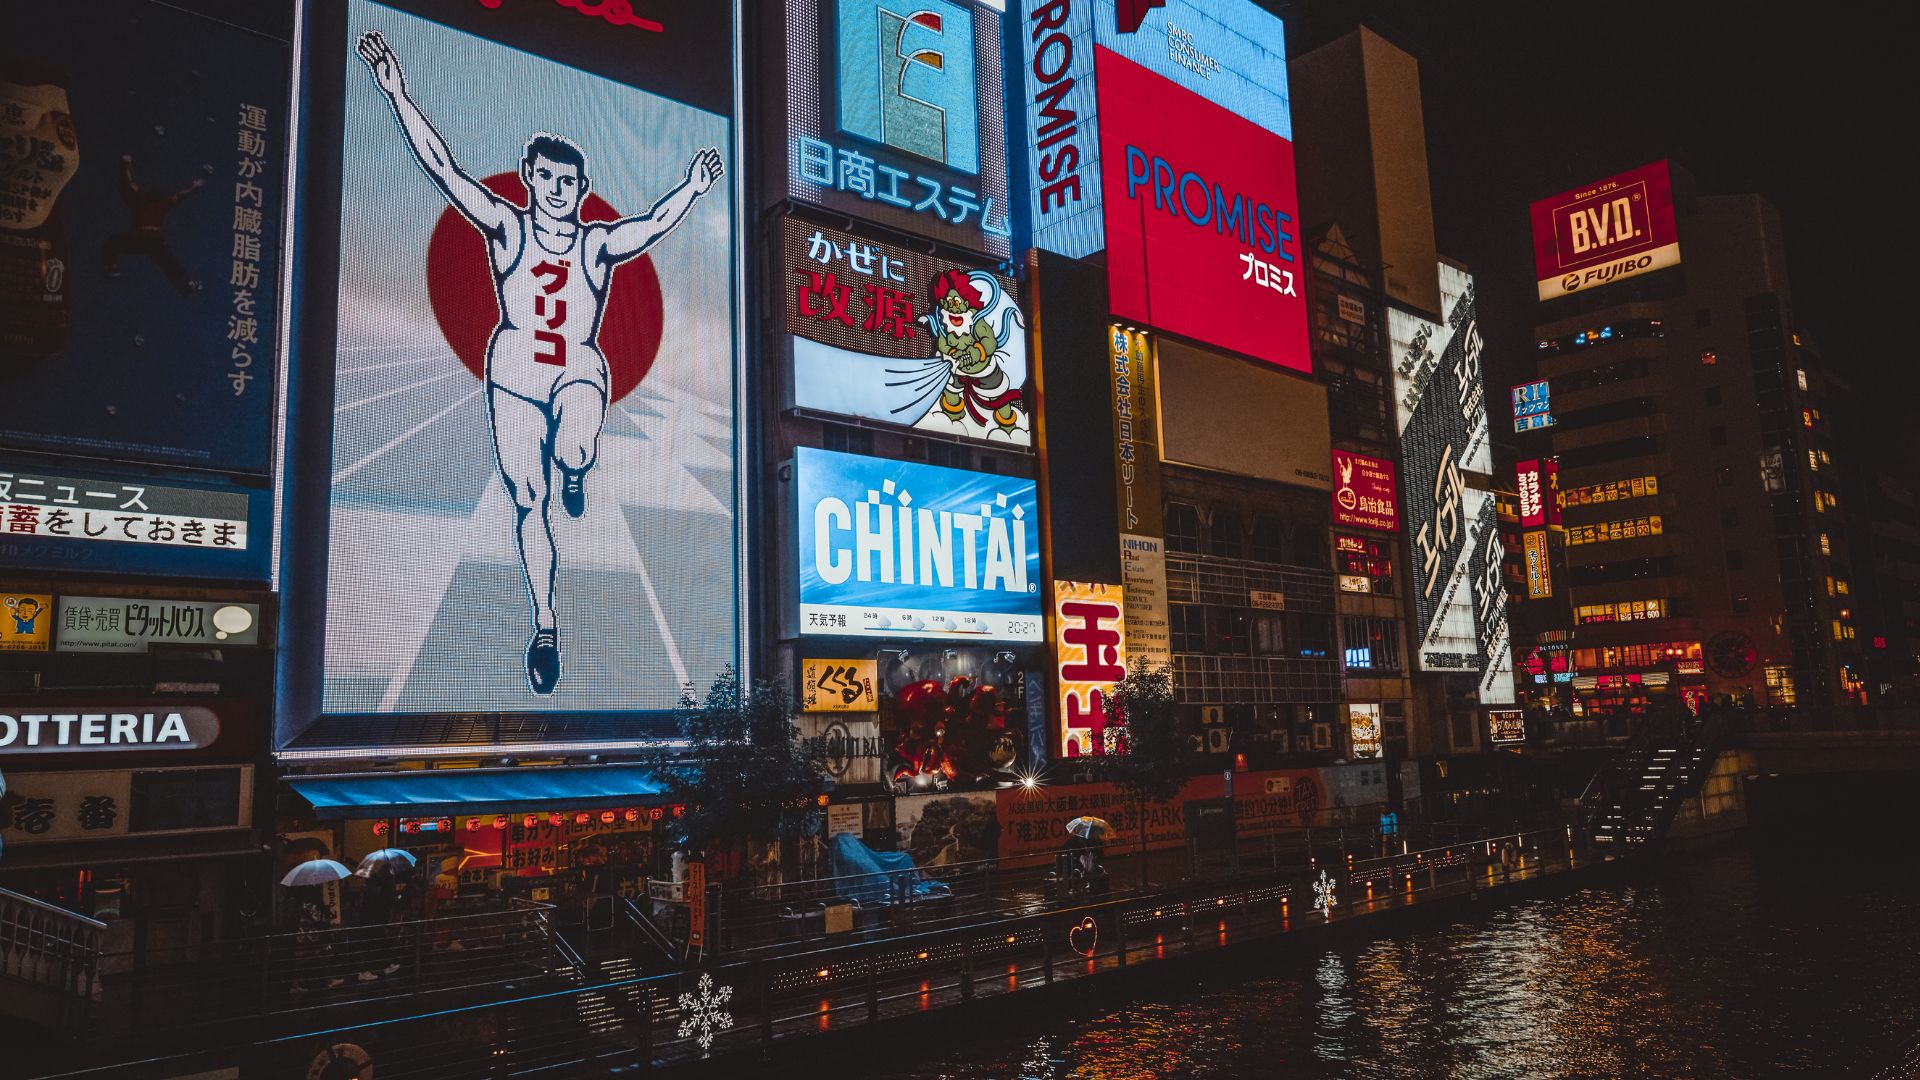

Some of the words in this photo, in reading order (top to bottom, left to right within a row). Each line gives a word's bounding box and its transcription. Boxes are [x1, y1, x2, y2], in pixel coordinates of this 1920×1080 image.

[1167, 21, 1194, 42] SMBC
[1168, 35, 1220, 73] CONSUMER
[1169, 47, 1212, 80] FINANCE
[799, 136, 1012, 237] 日商エステム
[1125, 143, 1295, 262] PROMISE
[1575, 189, 1597, 199] Since
[1569, 196, 1641, 254] B.V.D.
[226, 103, 269, 396] 運動が内臓脂肪を減らす
[806, 230, 906, 283] かぜに
[1583, 255, 1653, 282] FUJIBO
[1239, 252, 1298, 298] プロミス
[529, 259, 572, 368] グリコ
[794, 266, 917, 340] 改源
[1113, 331, 1139, 530] 株式会社日本リート
[1517, 473, 1530, 518] JOYSOUND
[1527, 470, 1542, 516] カラオケ
[0, 504, 238, 546] 蓄をしておきま
[814, 479, 1027, 592] CHINTAI
[1416, 444, 1465, 599] エイブル
[1123, 540, 1157, 552] NIHON
[1528, 550, 1542, 596] ネットルーム
[64, 606, 121, 632] 賃貸・売買
[124, 603, 206, 638] ピタットハウス
[809, 612, 847, 628] 天気予報
[1007, 620, 1036, 634] 20:27
[817, 665, 864, 705] くくる
